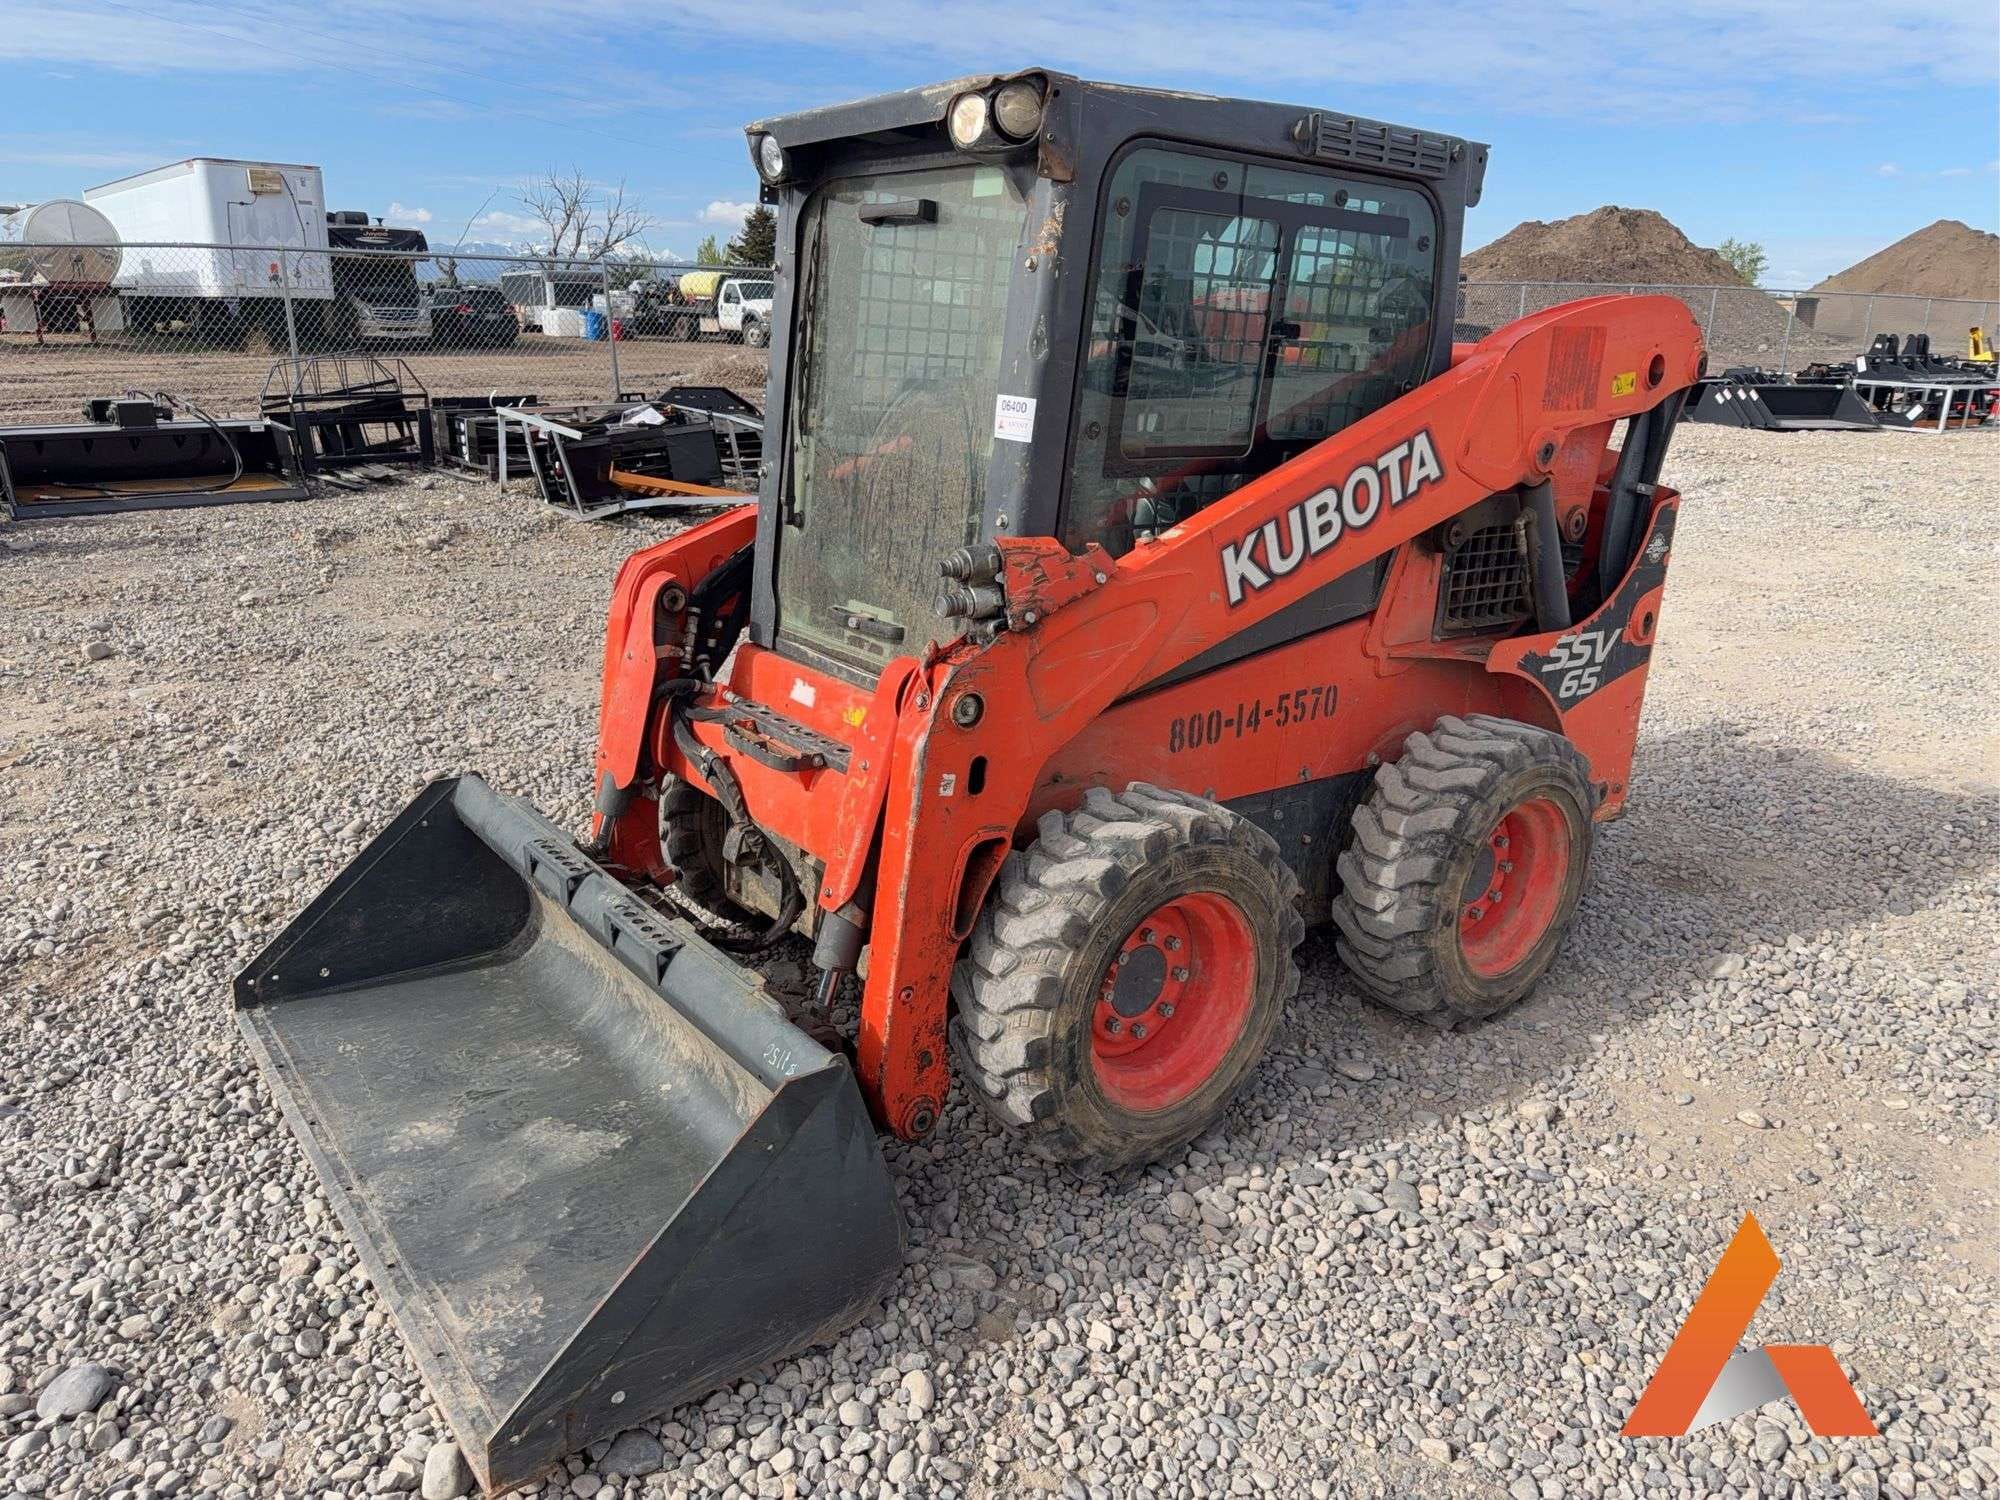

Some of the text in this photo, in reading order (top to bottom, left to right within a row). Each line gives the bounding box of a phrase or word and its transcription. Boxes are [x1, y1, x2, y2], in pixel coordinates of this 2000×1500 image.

[1001, 400, 1028, 414] 06400
[1220, 429, 1444, 606] KUBOTA
[1541, 628, 1624, 673] SSV
[1558, 665, 1602, 699] 65
[1168, 685, 1338, 754] 800-14-5570
